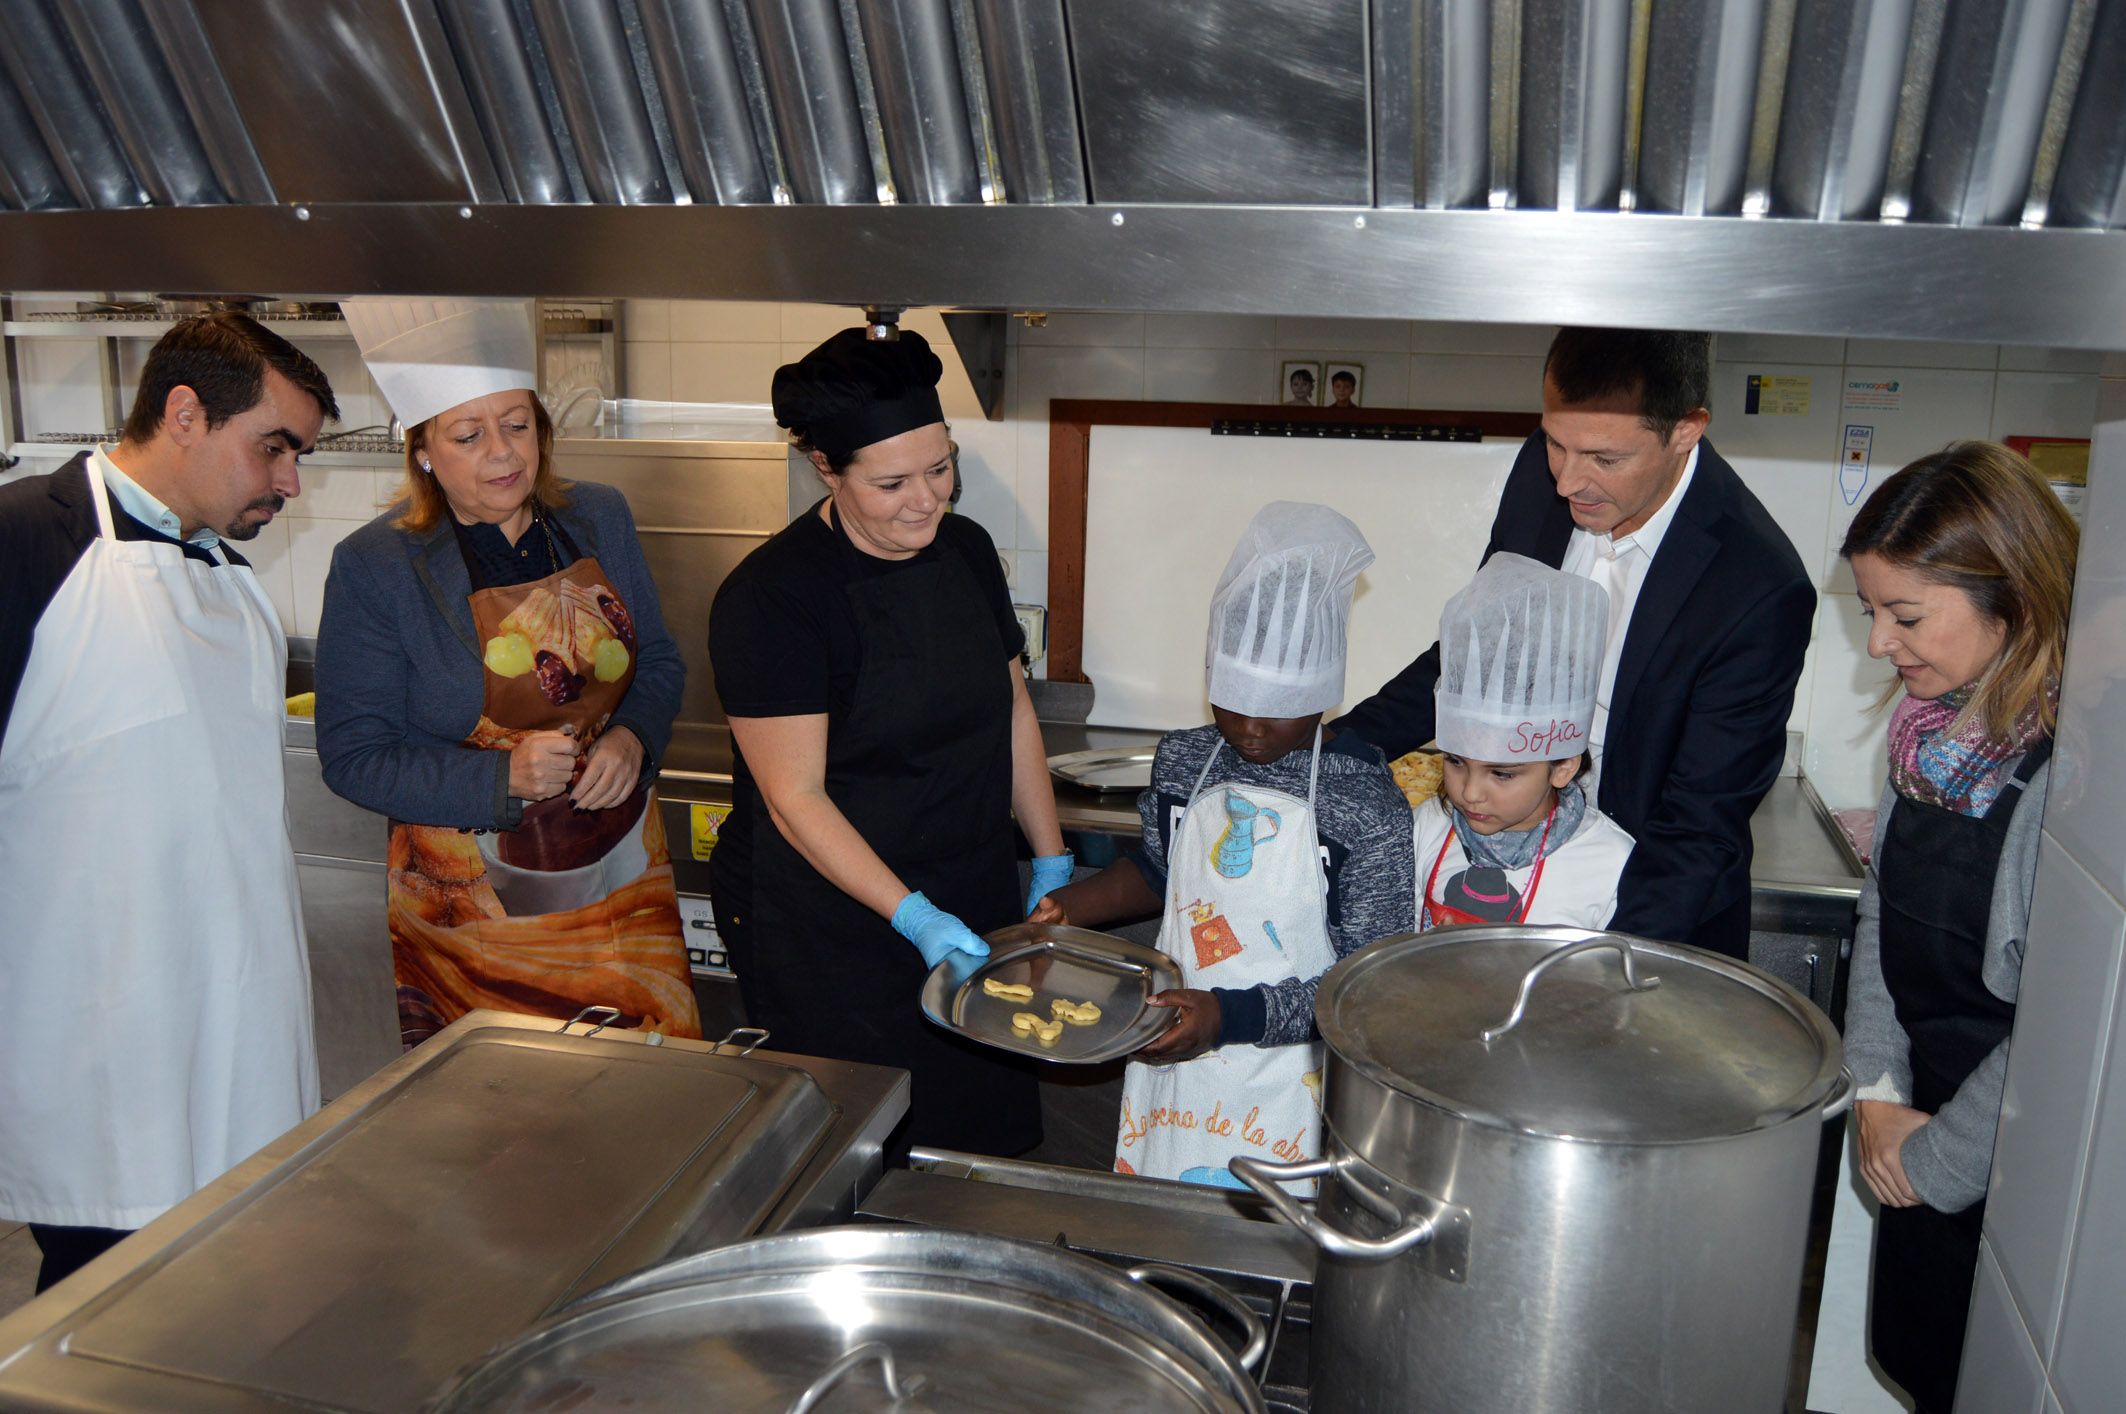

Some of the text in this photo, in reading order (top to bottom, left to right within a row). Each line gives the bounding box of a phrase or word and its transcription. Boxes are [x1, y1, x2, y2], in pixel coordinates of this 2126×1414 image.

[1508, 719, 1583, 755] Sofía
[1204, 1099, 1234, 1137] de
[1241, 1105, 1268, 1147] la
